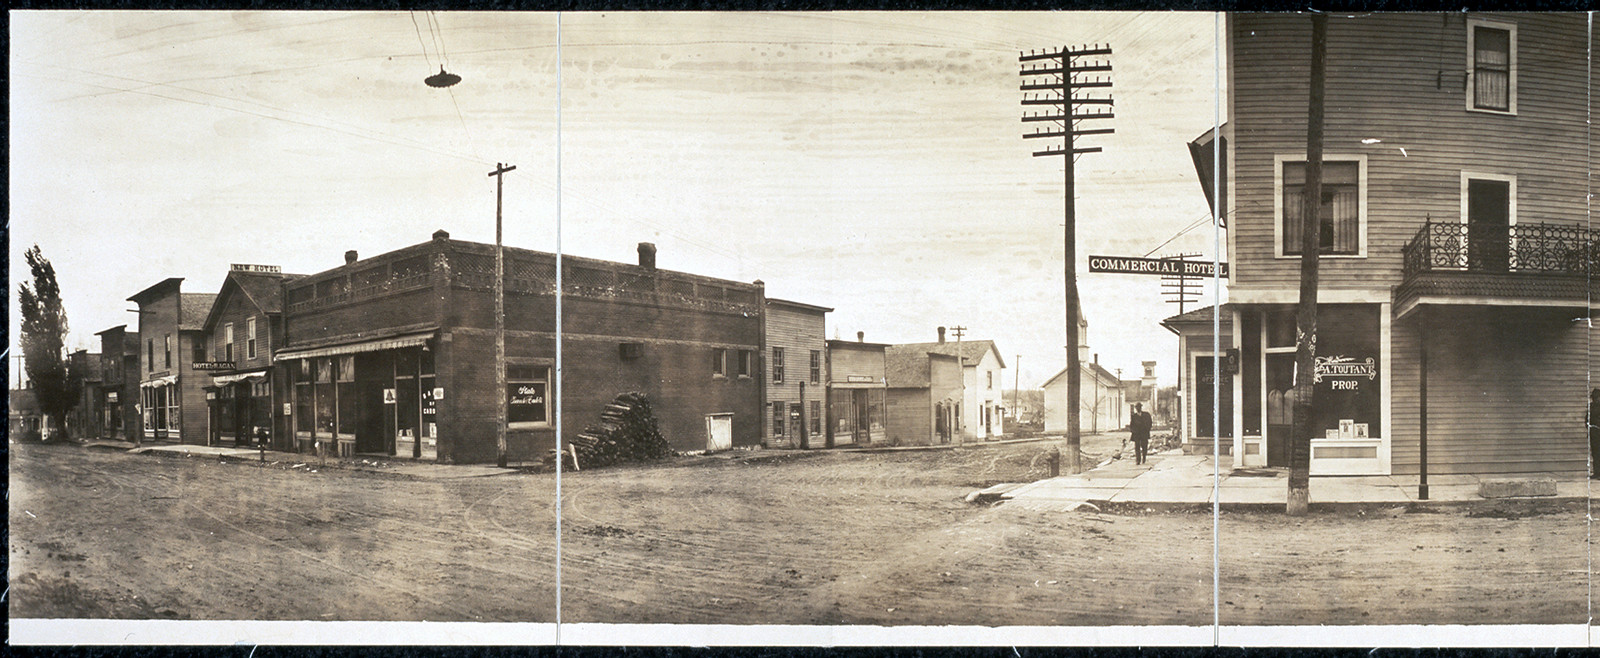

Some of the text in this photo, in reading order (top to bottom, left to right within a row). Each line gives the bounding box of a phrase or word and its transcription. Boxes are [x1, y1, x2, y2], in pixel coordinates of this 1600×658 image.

[254, 264, 278, 272] HOTEL
[1091, 258, 1227, 275] COMMERCIAL HOTEL
[1331, 380, 1359, 390] PROP.
